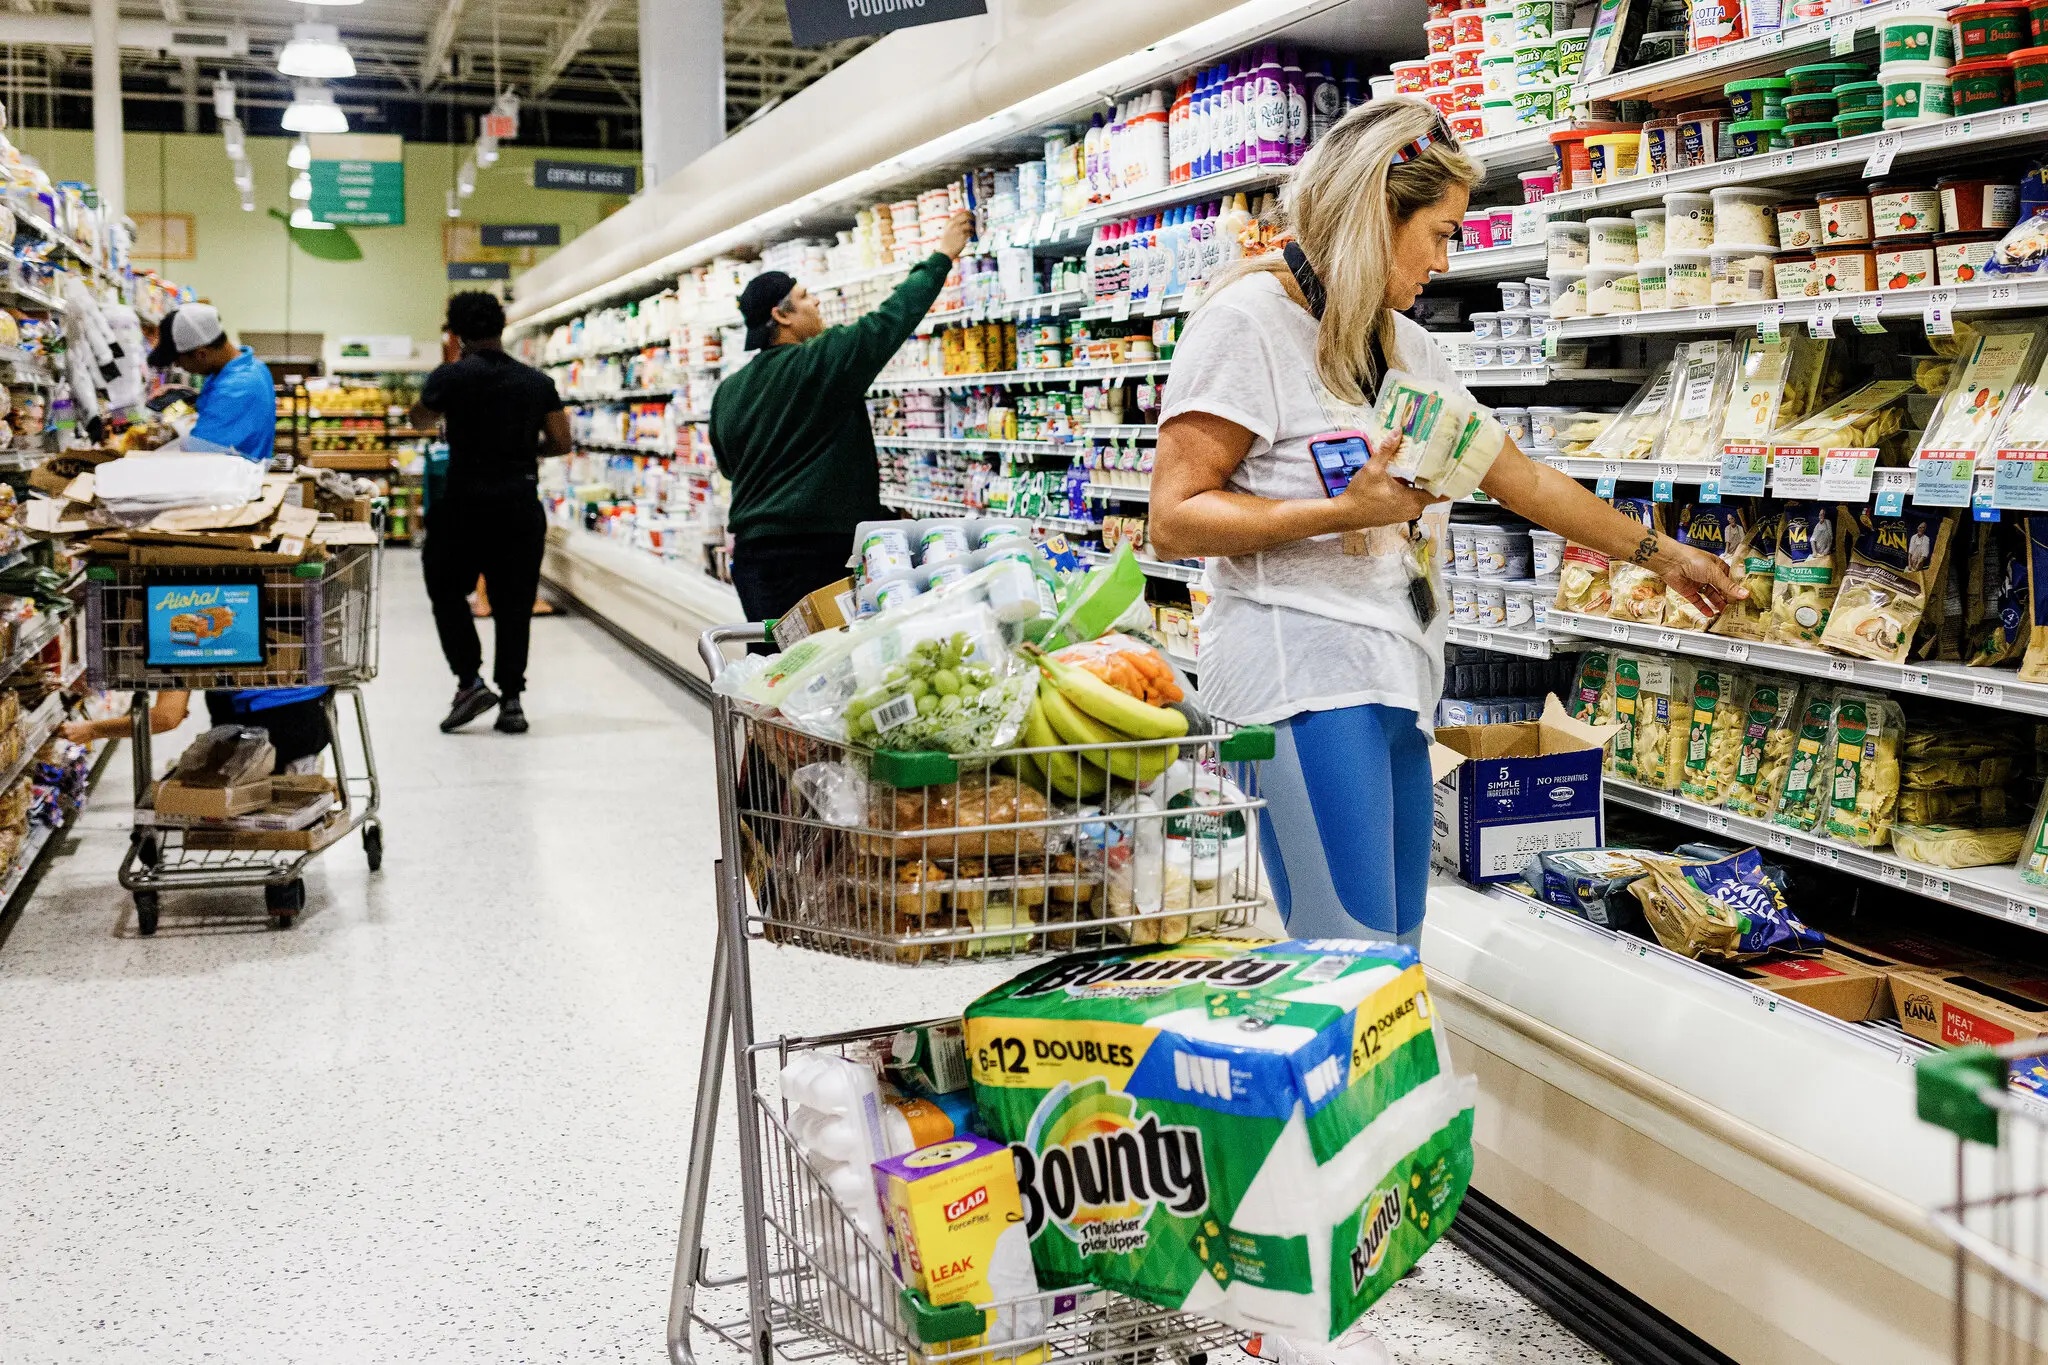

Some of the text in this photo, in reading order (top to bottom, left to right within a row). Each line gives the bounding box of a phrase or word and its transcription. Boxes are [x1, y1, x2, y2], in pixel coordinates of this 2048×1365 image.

[1879, 137, 1893, 149] 6.49
[1723, 166, 1736, 176] 4.99
[1651, 180, 1662, 188] 4.99
[1673, 263, 1697, 271] SHAVED
[1673, 271, 1707, 279] PARMESAN
[1931, 293, 1947, 303] 6.99
[1993, 288, 2010, 299] 2.55
[1817, 301, 1832, 311] 6.99
[1699, 312, 1711, 320] 4.49
[1622, 318, 1633, 327] 4.49
[1945, 451, 1955, 459] SAVE
[1606, 464, 1616, 472] 5.15
[1661, 467, 1672, 475] 5.15
[1887, 475, 1903, 486] 4.85
[1982, 479, 1993, 488] 4.8
[1879, 504, 1898, 514] organic
[1687, 522, 1723, 542] RANA
[1789, 527, 1808, 544] NA
[1877, 527, 1908, 551] RAN
[156, 586, 220, 611] Aloha!
[1614, 625, 1625, 635] 4.99
[1479, 633, 1488, 642] 7.59
[1662, 634, 1674, 643] 4.99
[1529, 643, 1540, 652] 7.59
[1730, 645, 1743, 655] 4.99
[1832, 661, 1847, 672] 4.99
[1977, 684, 1995, 696] 7.09
[1500, 766, 1510, 781] 5
[1487, 780, 1520, 790] SIMPLE
[1537, 773, 1588, 786] NO PRESERVATIVES
[1487, 788, 1520, 798] INGREDIENTS
[1723, 879, 1780, 925] AMILY
[1014, 956, 1298, 998] Bounty
[1904, 1000, 1937, 1024] RANA
[1947, 1012, 1974, 1032] MEAT
[978, 1037, 1135, 1074] 6=12 DOUBLES
[1904, 1054, 1917, 1068] 3.2
[1011, 1116, 1207, 1240] Bounty
[946, 1188, 986, 1221] GLAD
[948, 1212, 990, 1233] ForceFlex
[1080, 1219, 1141, 1240] The Quicker
[1110, 1233, 1146, 1251] Upper
[1350, 1187, 1401, 1289] Bounty
[931, 1255, 974, 1282] LEAK
